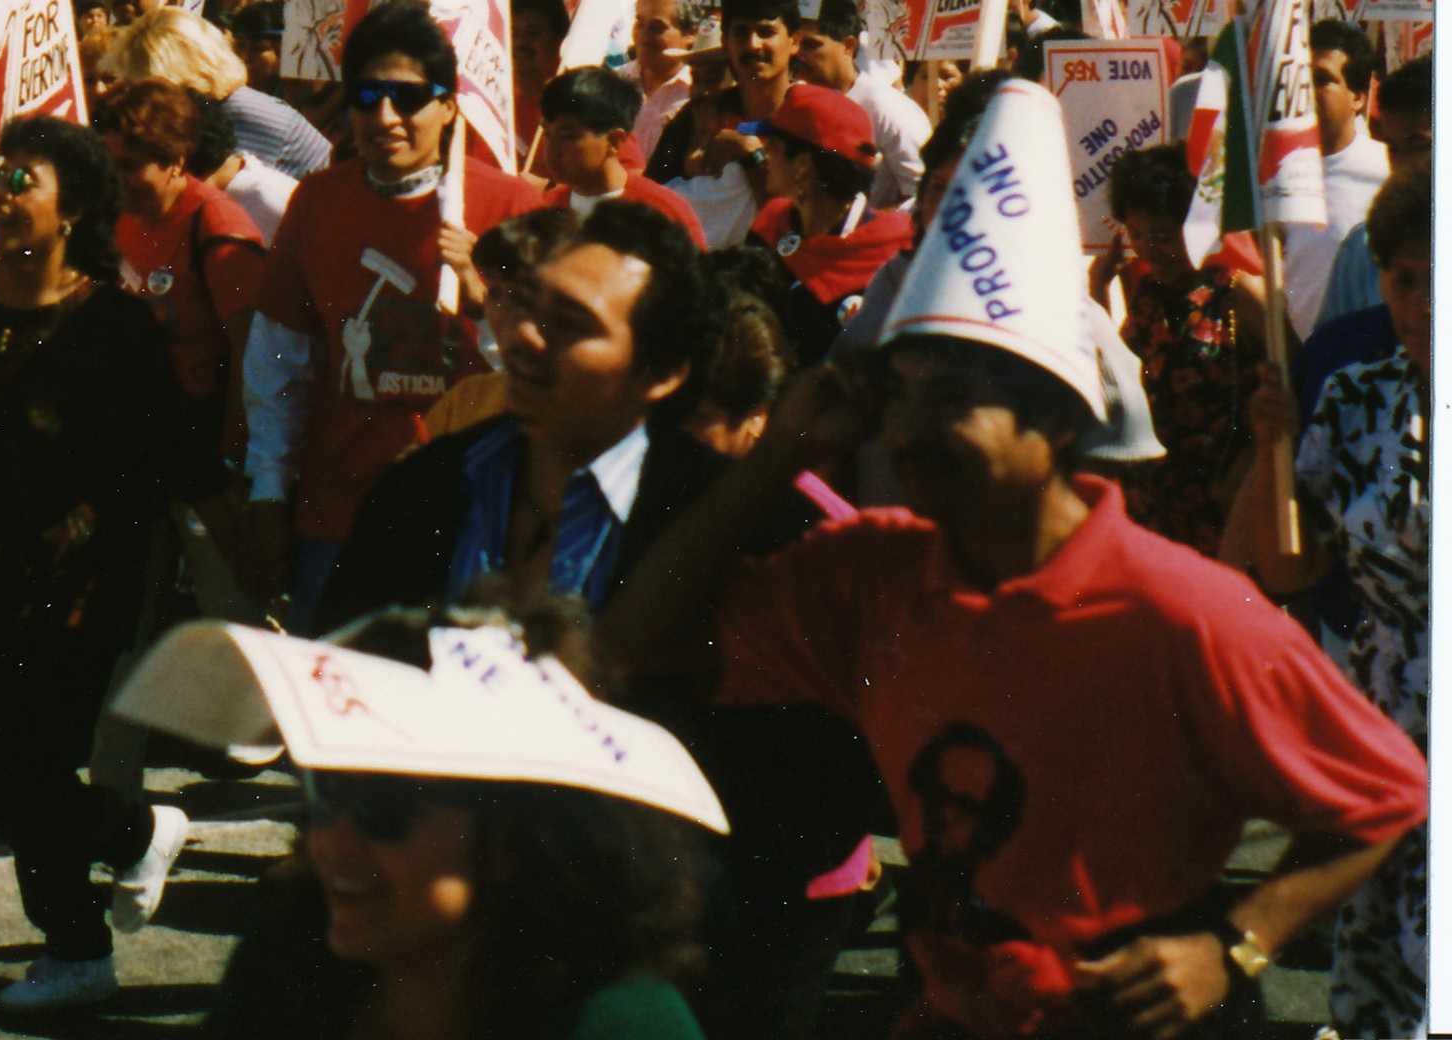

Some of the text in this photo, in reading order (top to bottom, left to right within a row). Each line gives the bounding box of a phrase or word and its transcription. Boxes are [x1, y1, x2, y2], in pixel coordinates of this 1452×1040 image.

[23, 0, 60, 60] FOR
[18, 32, 72, 108] EVERYONE
[1108, 59, 1153, 81] VOTE
[1073, 110, 1162, 199] PROPOSITIO
[1079, 117, 1119, 157] ONE
[971, 143, 1030, 218] ONE
